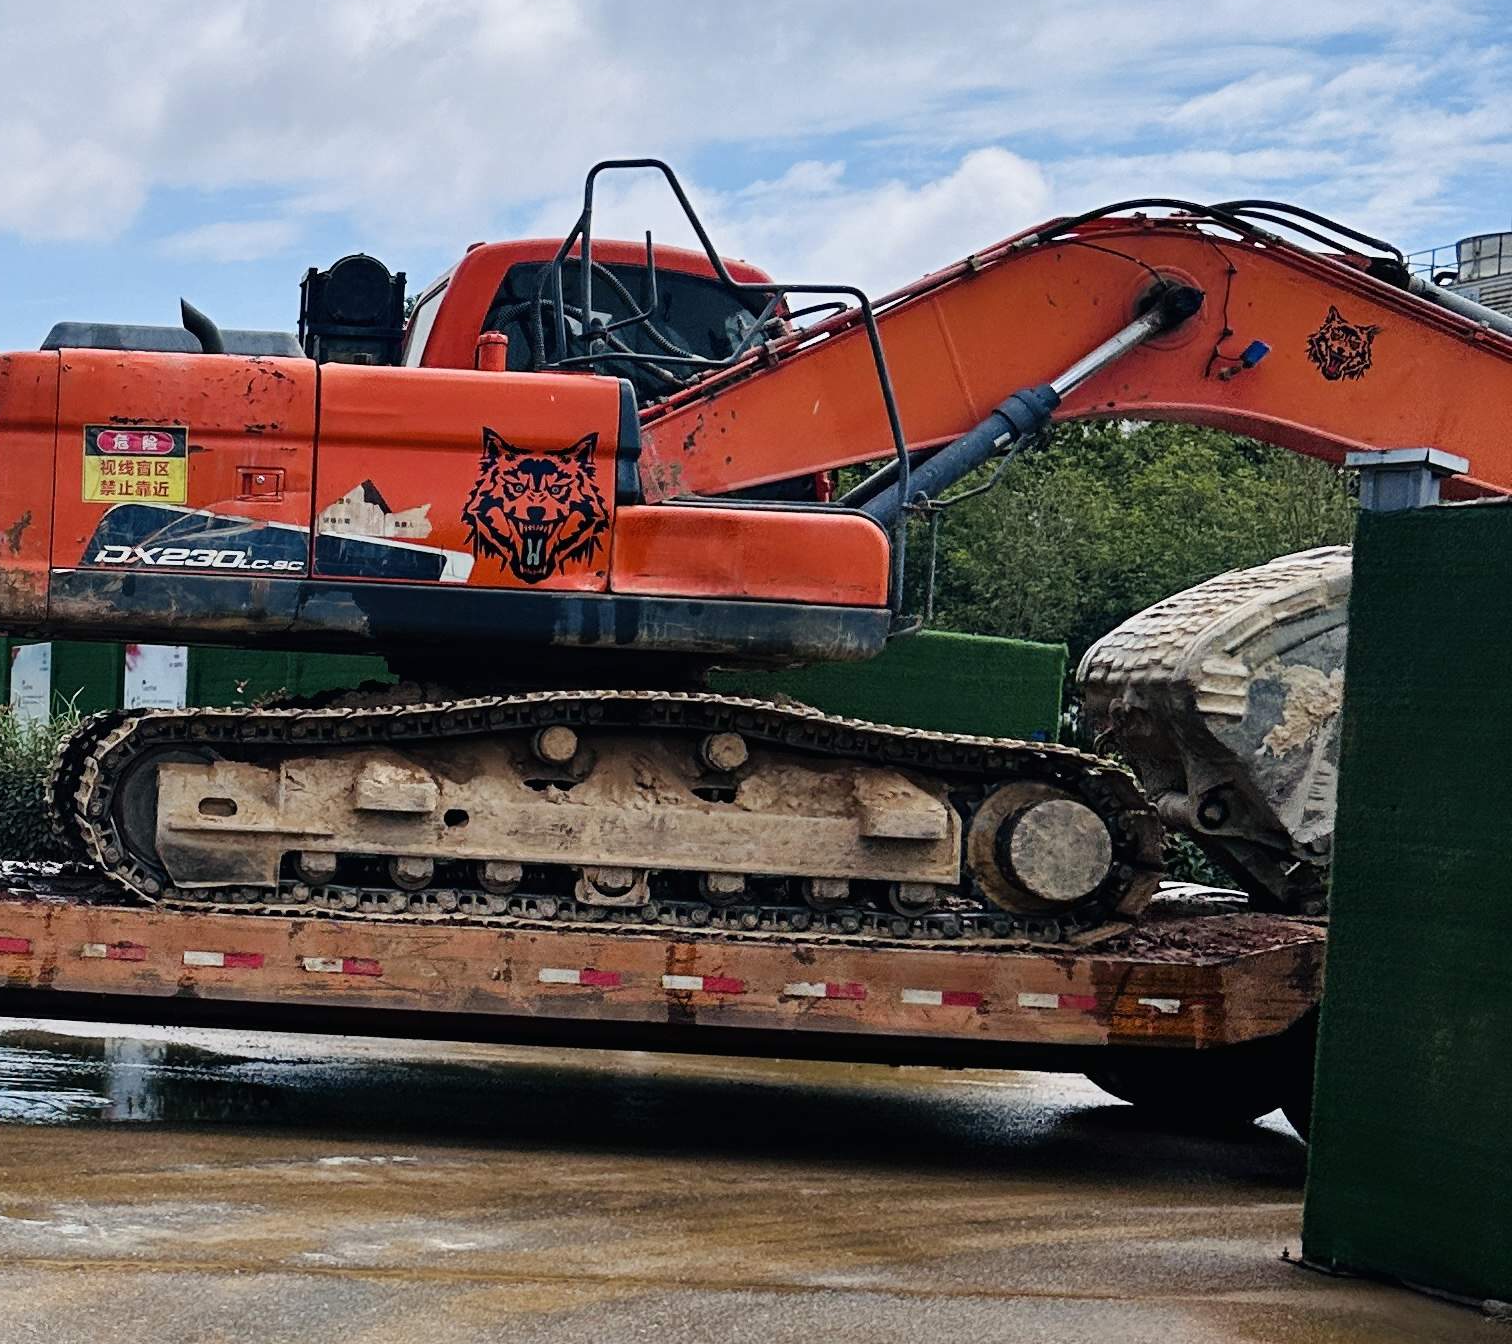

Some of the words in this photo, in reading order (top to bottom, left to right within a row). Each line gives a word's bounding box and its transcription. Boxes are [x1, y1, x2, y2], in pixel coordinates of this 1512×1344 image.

[100, 459, 170, 477] 视线盲区
[100, 479, 170, 497] 禁止靠近
